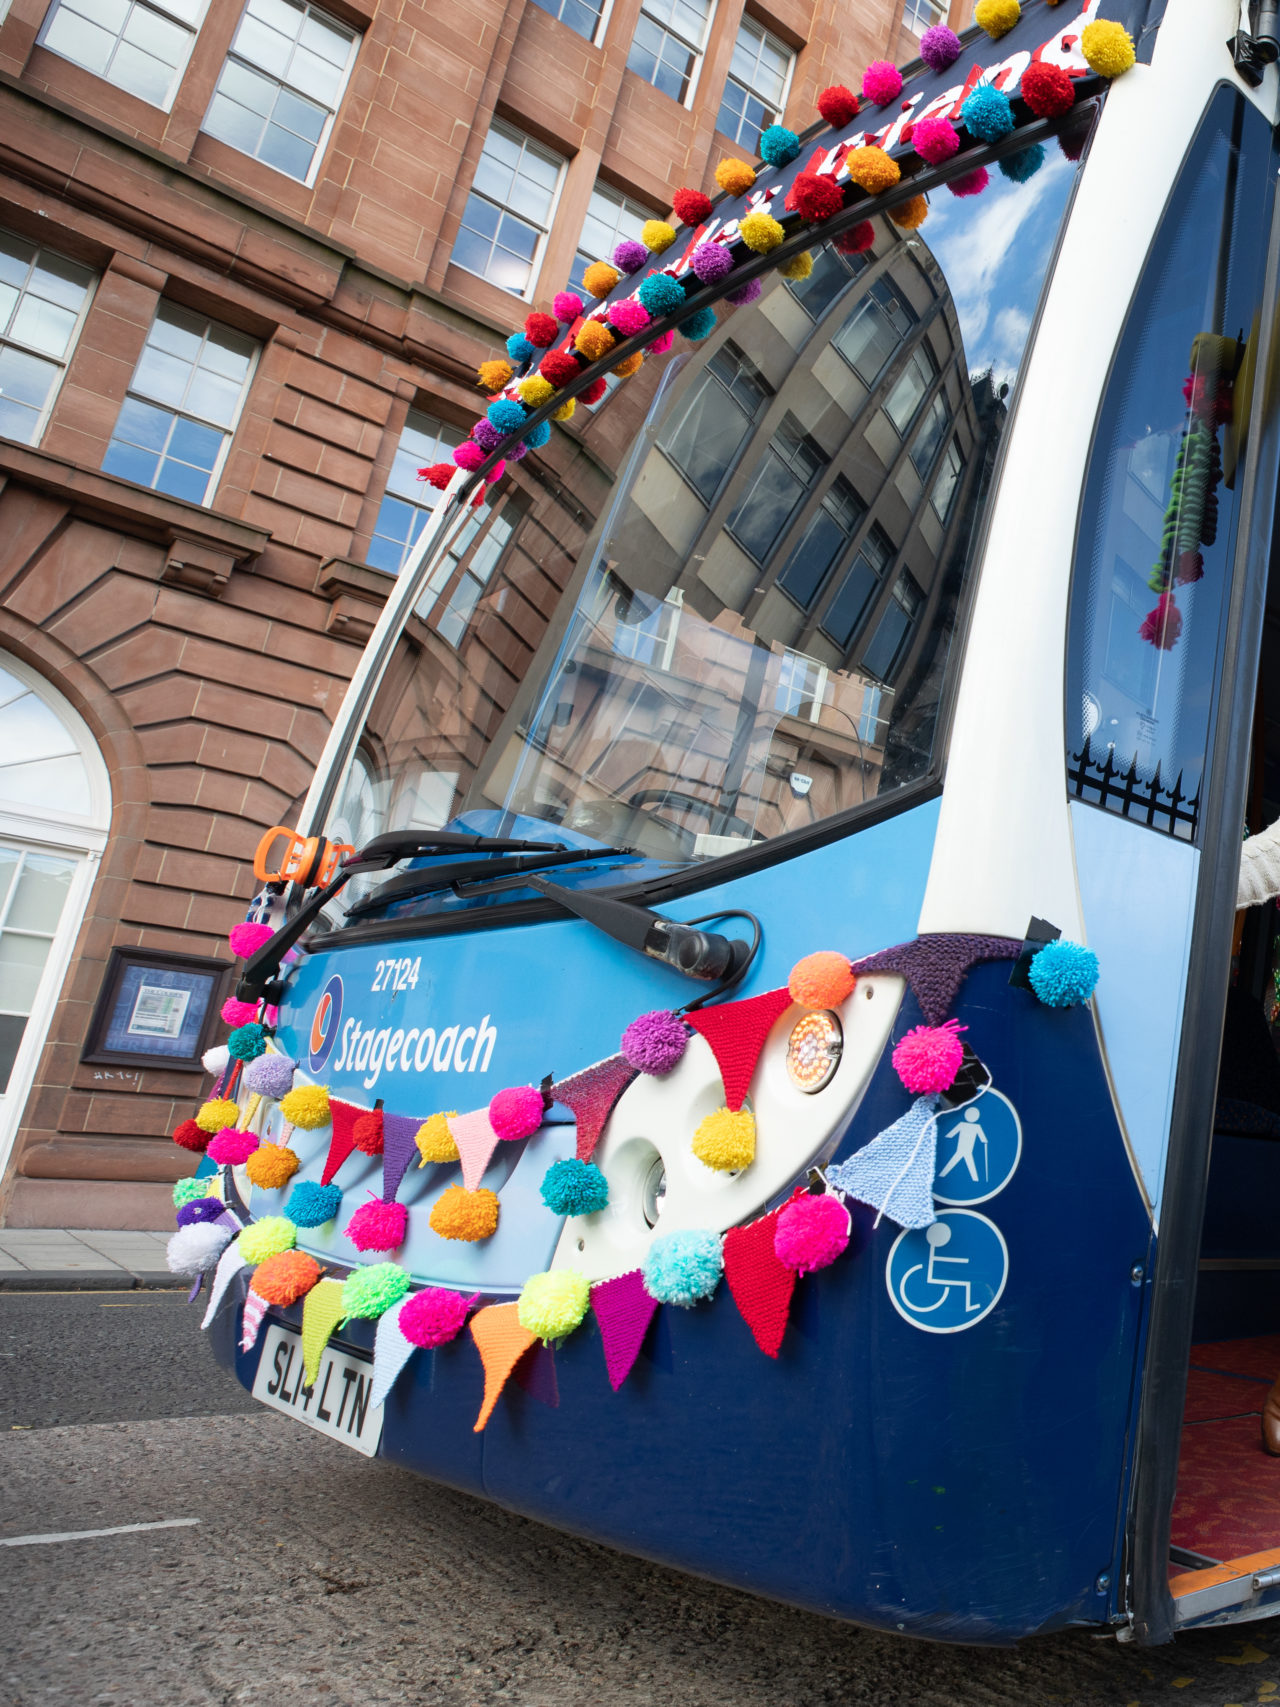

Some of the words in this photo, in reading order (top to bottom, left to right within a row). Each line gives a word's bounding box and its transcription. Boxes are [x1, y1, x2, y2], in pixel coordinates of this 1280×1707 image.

[371, 956, 422, 992] 27124
[334, 1013, 498, 1089] Stagecoach
[316, 1361, 374, 1439] LTN
